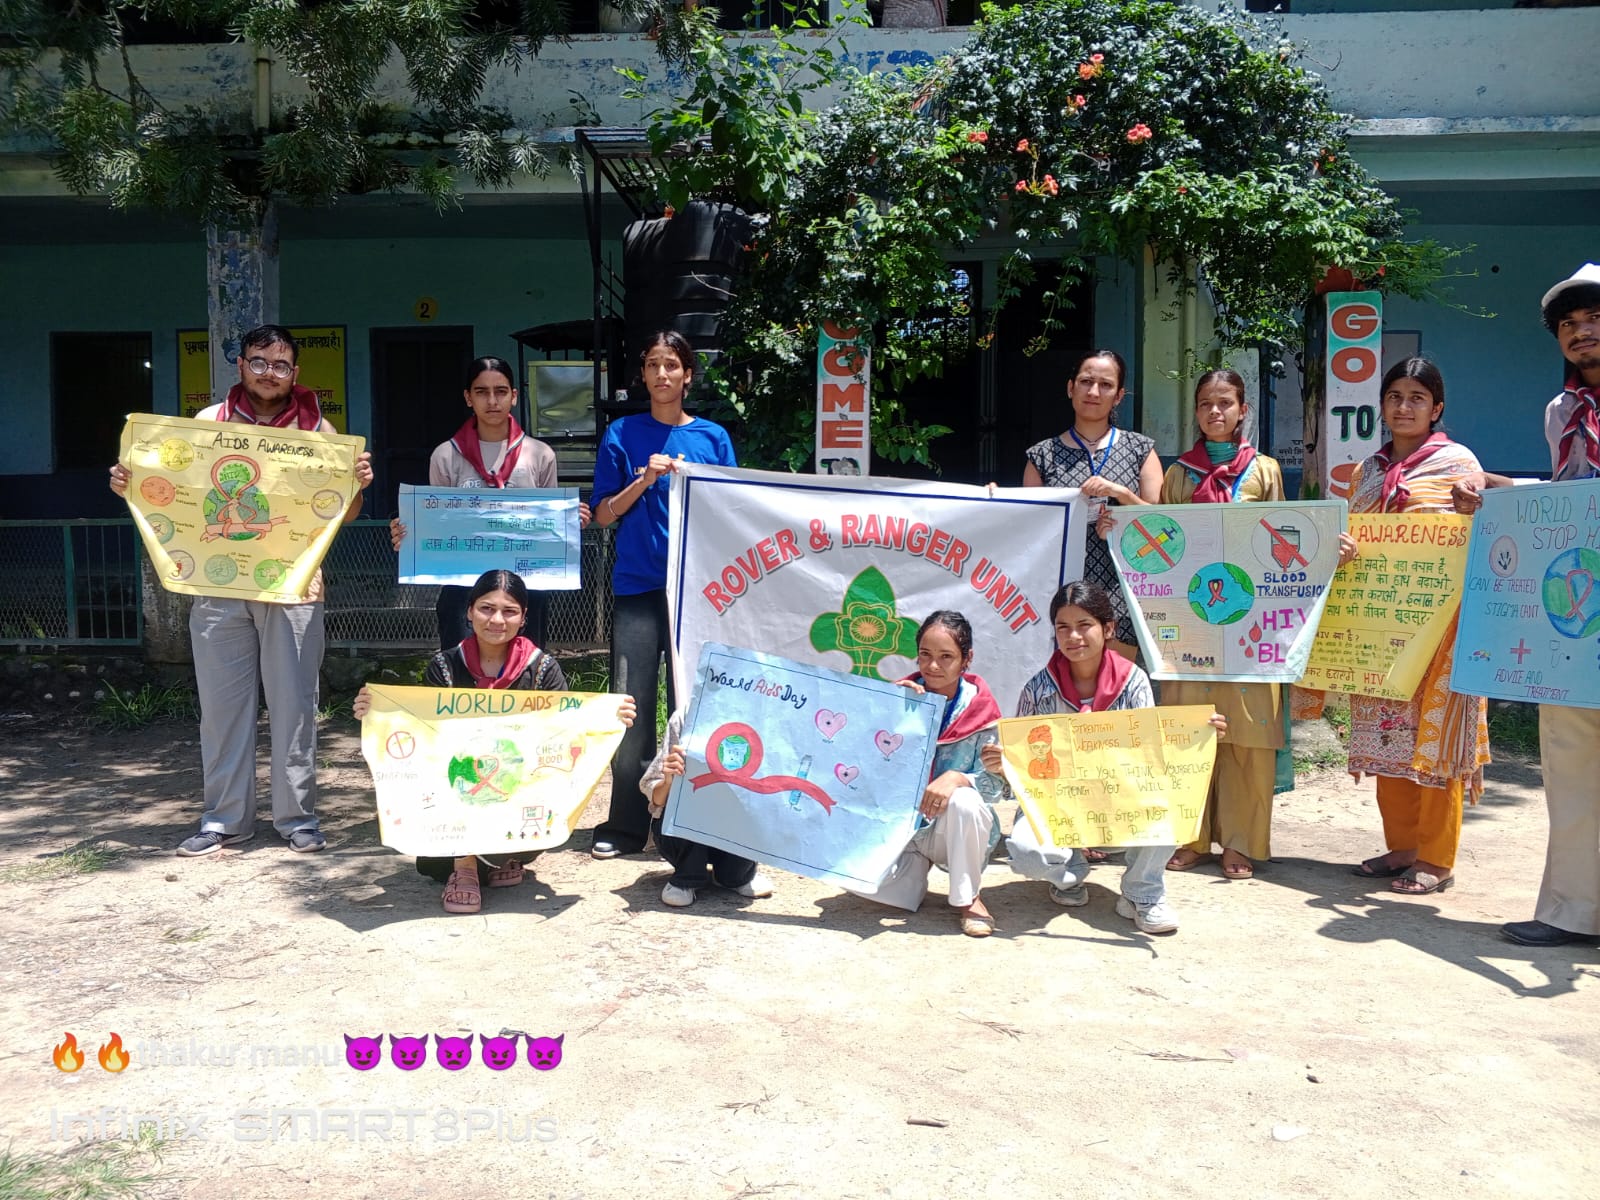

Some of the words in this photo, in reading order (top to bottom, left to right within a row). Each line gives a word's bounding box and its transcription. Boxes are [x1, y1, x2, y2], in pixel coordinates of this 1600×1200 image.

[420, 302, 430, 318] 2
[1331, 304, 1379, 383] GO
[1330, 404, 1375, 442] TO
[212, 432, 249, 450] AIDS
[257, 439, 314, 457] AWARENESS
[1517, 495, 1572, 524] WORLD
[1585, 495, 1600, 521] A
[1357, 524, 1467, 548] AWARENESS
[1481, 522, 1499, 536] HIV
[1533, 525, 1578, 549] STOP
[1584, 527, 1600, 549] H
[703, 528, 803, 615] ROVER
[809, 518, 832, 551] &
[841, 514, 970, 577] RANGER
[970, 558, 1040, 634] UNIT
[1122, 572, 1147, 583] TOP
[1263, 572, 1307, 583] BLOOD
[1133, 584, 1173, 596] ARING
[1468, 577, 1490, 591] CAN
[1493, 577, 1504, 592] BE
[1507, 579, 1536, 595] TREATED
[1485, 602, 1519, 618] STIGMA
[1364, 672, 1386, 686] HIV
[437, 692, 515, 714] WORLD
[520, 696, 552, 711] AIDS
[559, 697, 583, 712] DAY
[781, 685, 807, 709] Day
[536, 744, 564, 756] CHECK
[1096, 766, 1115, 779] YOU
[1101, 780, 1120, 794] YOU
[1136, 779, 1164, 791] WILL
[1115, 809, 1140, 822] STOP
[1146, 807, 1168, 821] NOT
